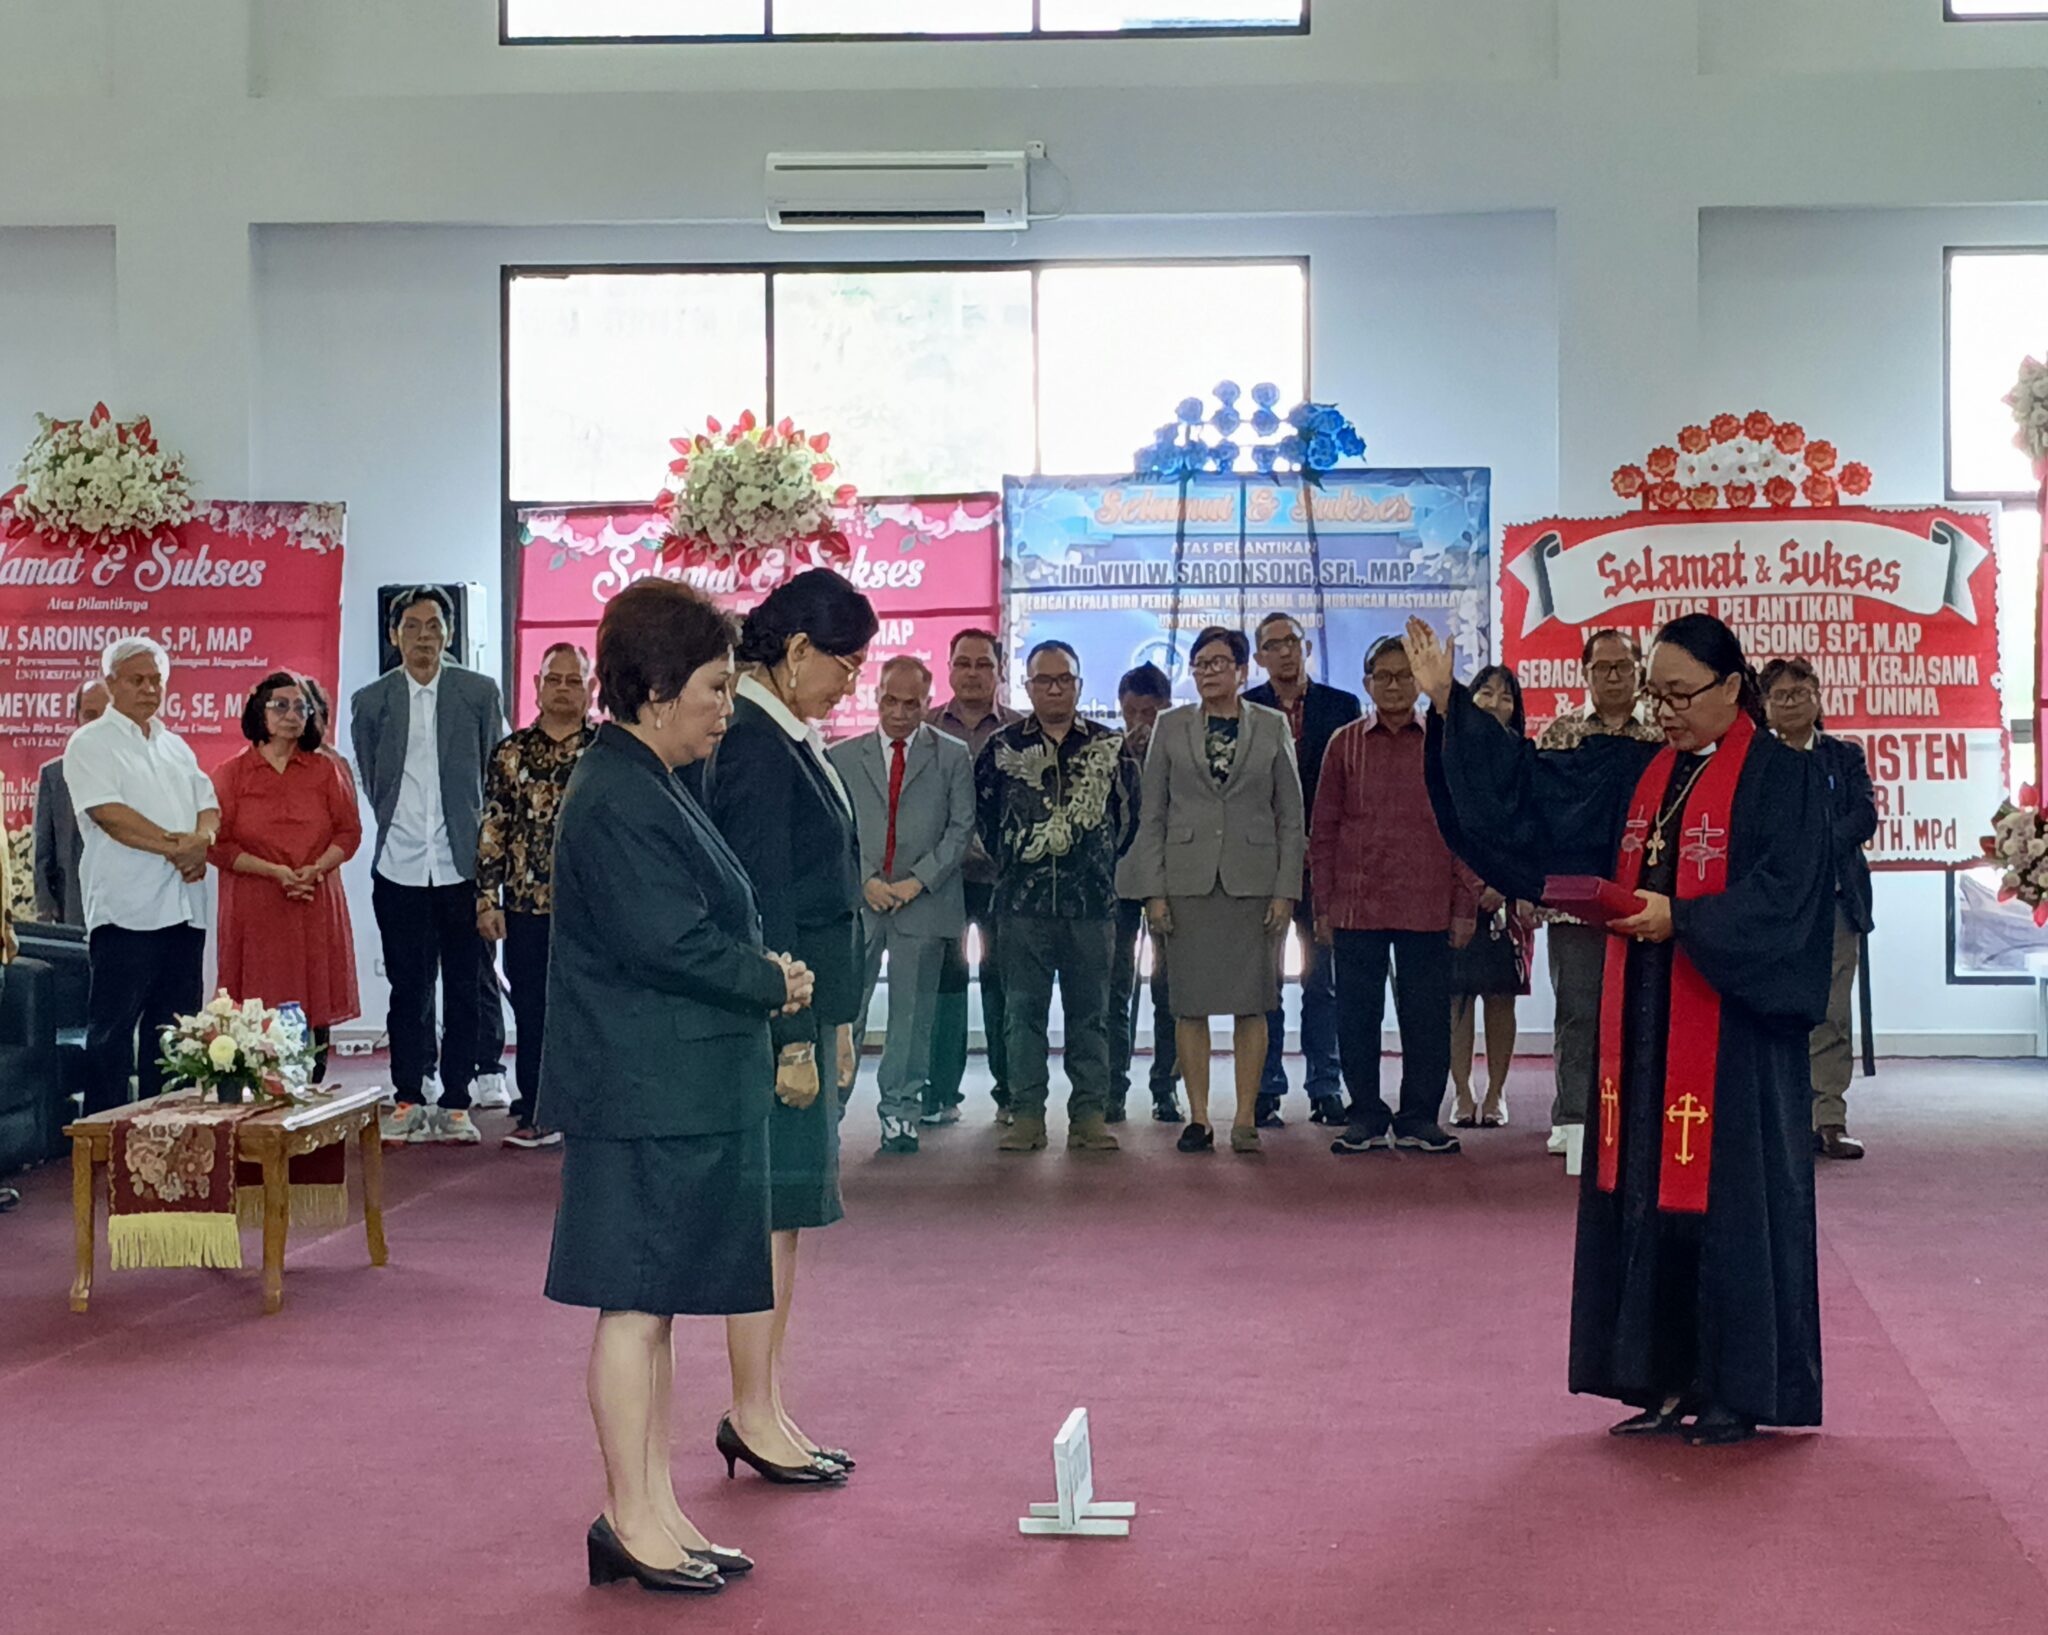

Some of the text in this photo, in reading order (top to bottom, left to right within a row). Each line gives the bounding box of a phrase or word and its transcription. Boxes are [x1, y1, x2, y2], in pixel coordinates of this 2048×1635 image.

[91, 544, 128, 586] &
[134, 537, 267, 592] Sukses
[1060, 562, 1095, 585] Ibu
[1370, 561, 1415, 584] MAP
[1597, 538, 1901, 598] Selamat & Sukses
[77, 597, 148, 614] Dilantiknya
[1653, 597, 1854, 624] ATAS PELANTIKAN
[206, 627, 252, 652] MAP
[191, 693, 220, 722] SE,
[1866, 687, 1940, 716] UNIMA
